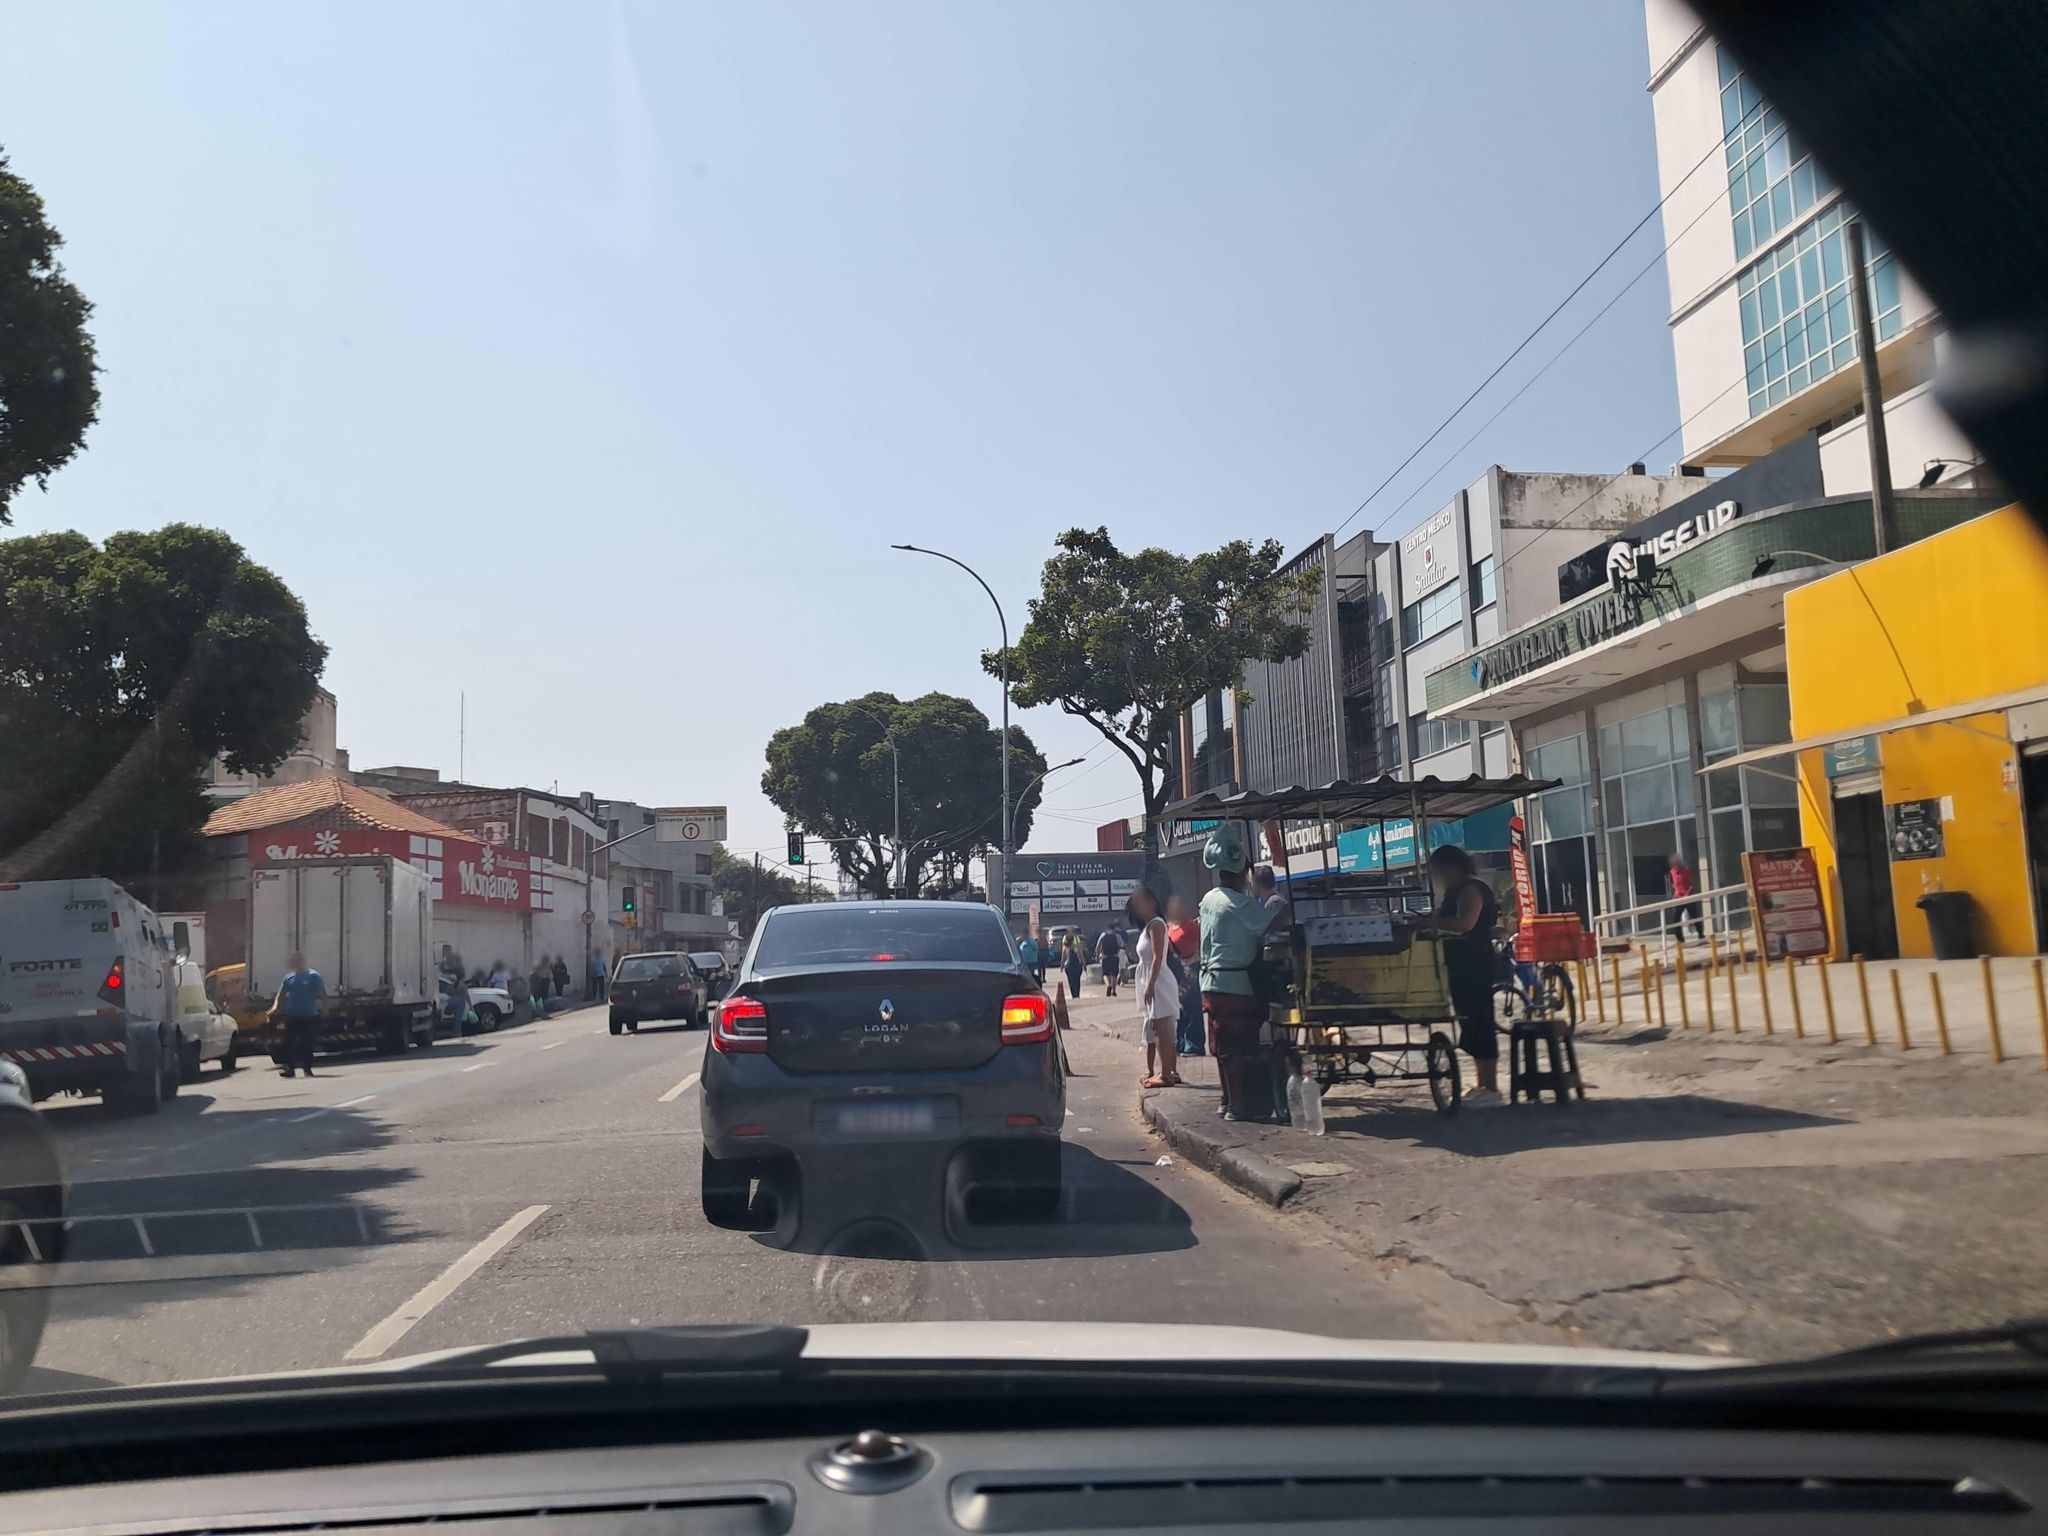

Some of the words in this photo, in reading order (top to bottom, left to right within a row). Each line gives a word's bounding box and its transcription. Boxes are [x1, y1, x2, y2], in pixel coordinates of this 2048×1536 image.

[1406, 529, 1427, 553] CENTRO
[1428, 511, 1451, 537] MÉDICO
[1696, 500, 1738, 537] UP
[1486, 621, 1568, 682] MONTBLANC
[1574, 592, 1637, 645] TOWERS
[458, 860, 520, 905] Monamie
[9, 958, 82, 973] FORTE
[864, 1023, 909, 1032] LOGAN
